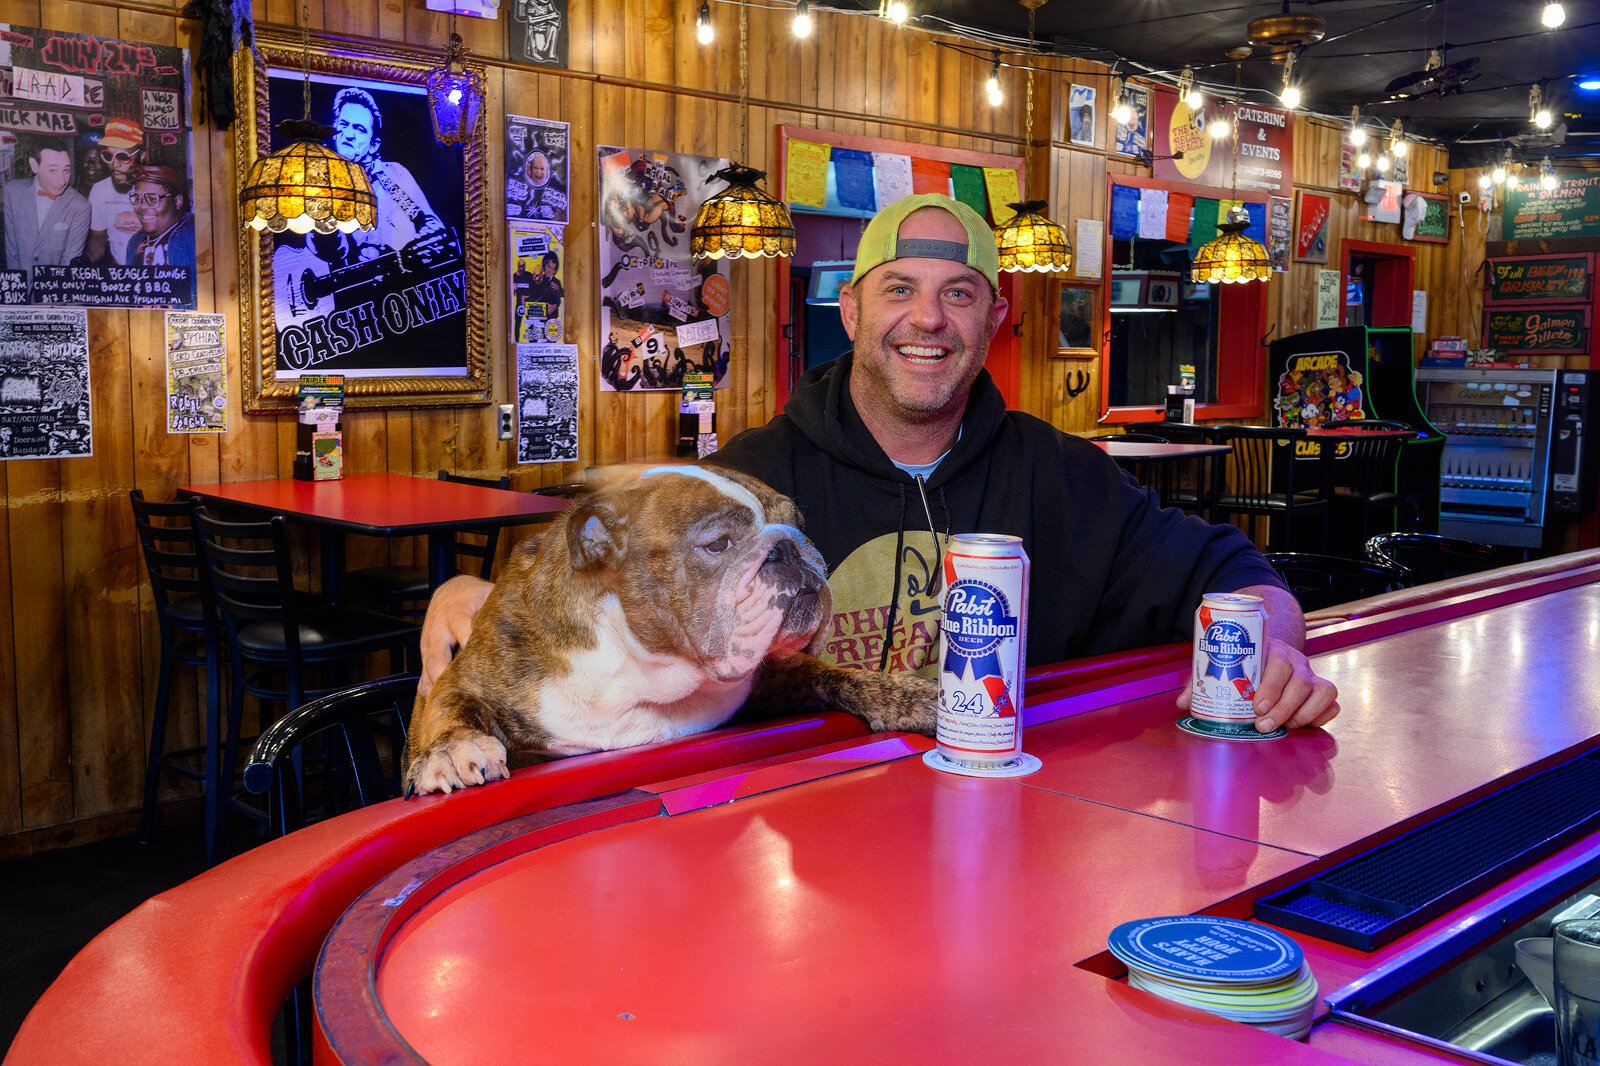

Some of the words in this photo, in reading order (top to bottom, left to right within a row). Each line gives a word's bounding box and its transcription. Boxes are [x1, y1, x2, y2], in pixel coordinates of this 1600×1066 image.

[44, 37, 98, 71] JULY
[16, 70, 71, 99] LRAD
[144, 105, 174, 114] NAMED
[1238, 107, 1285, 128] CATERING
[36, 112, 74, 131] MAZ
[1172, 125, 1188, 137] THE
[1174, 132, 1201, 146] REGAL
[1257, 128, 1267, 141] &
[1241, 143, 1280, 161] EVENTS
[646, 165, 672, 183] REGAL
[1539, 188, 1586, 200] SALMON
[1300, 204, 1325, 248] Coors
[50, 267, 66, 277] THE
[71, 267, 104, 280] REGAL
[108, 267, 149, 280] BEAGLE
[154, 267, 187, 280] LOUNGE
[1496, 265, 1524, 279] Full
[1528, 264, 1564, 277] BEEF
[34, 280, 59, 290] CASH
[145, 282, 171, 294] BBQ
[1500, 279, 1569, 293] BRISKET
[42, 294, 59, 303] 817
[72, 293, 114, 304] MICHIGAN
[280, 300, 384, 371] CASH
[382, 269, 466, 334] ONLY
[183, 331, 219, 345] PYTHIAN
[646, 337, 658, 354] 9
[1295, 355, 1338, 371] ARCADE
[950, 588, 996, 616] Pabst
[833, 604, 904, 638] THE
[961, 616, 1015, 637] Ribbon
[958, 636, 983, 644] BEER
[1210, 626, 1242, 643] Pabst
[1200, 639, 1218, 652] Blue
[1220, 641, 1254, 655] Ribbon
[1215, 686, 1232, 698] 12
[952, 690, 983, 715] 24
[1152, 941, 1215, 966] HAAB'S
[1172, 939, 1229, 962] HAPPY
[1194, 935, 1243, 955] HOUR
